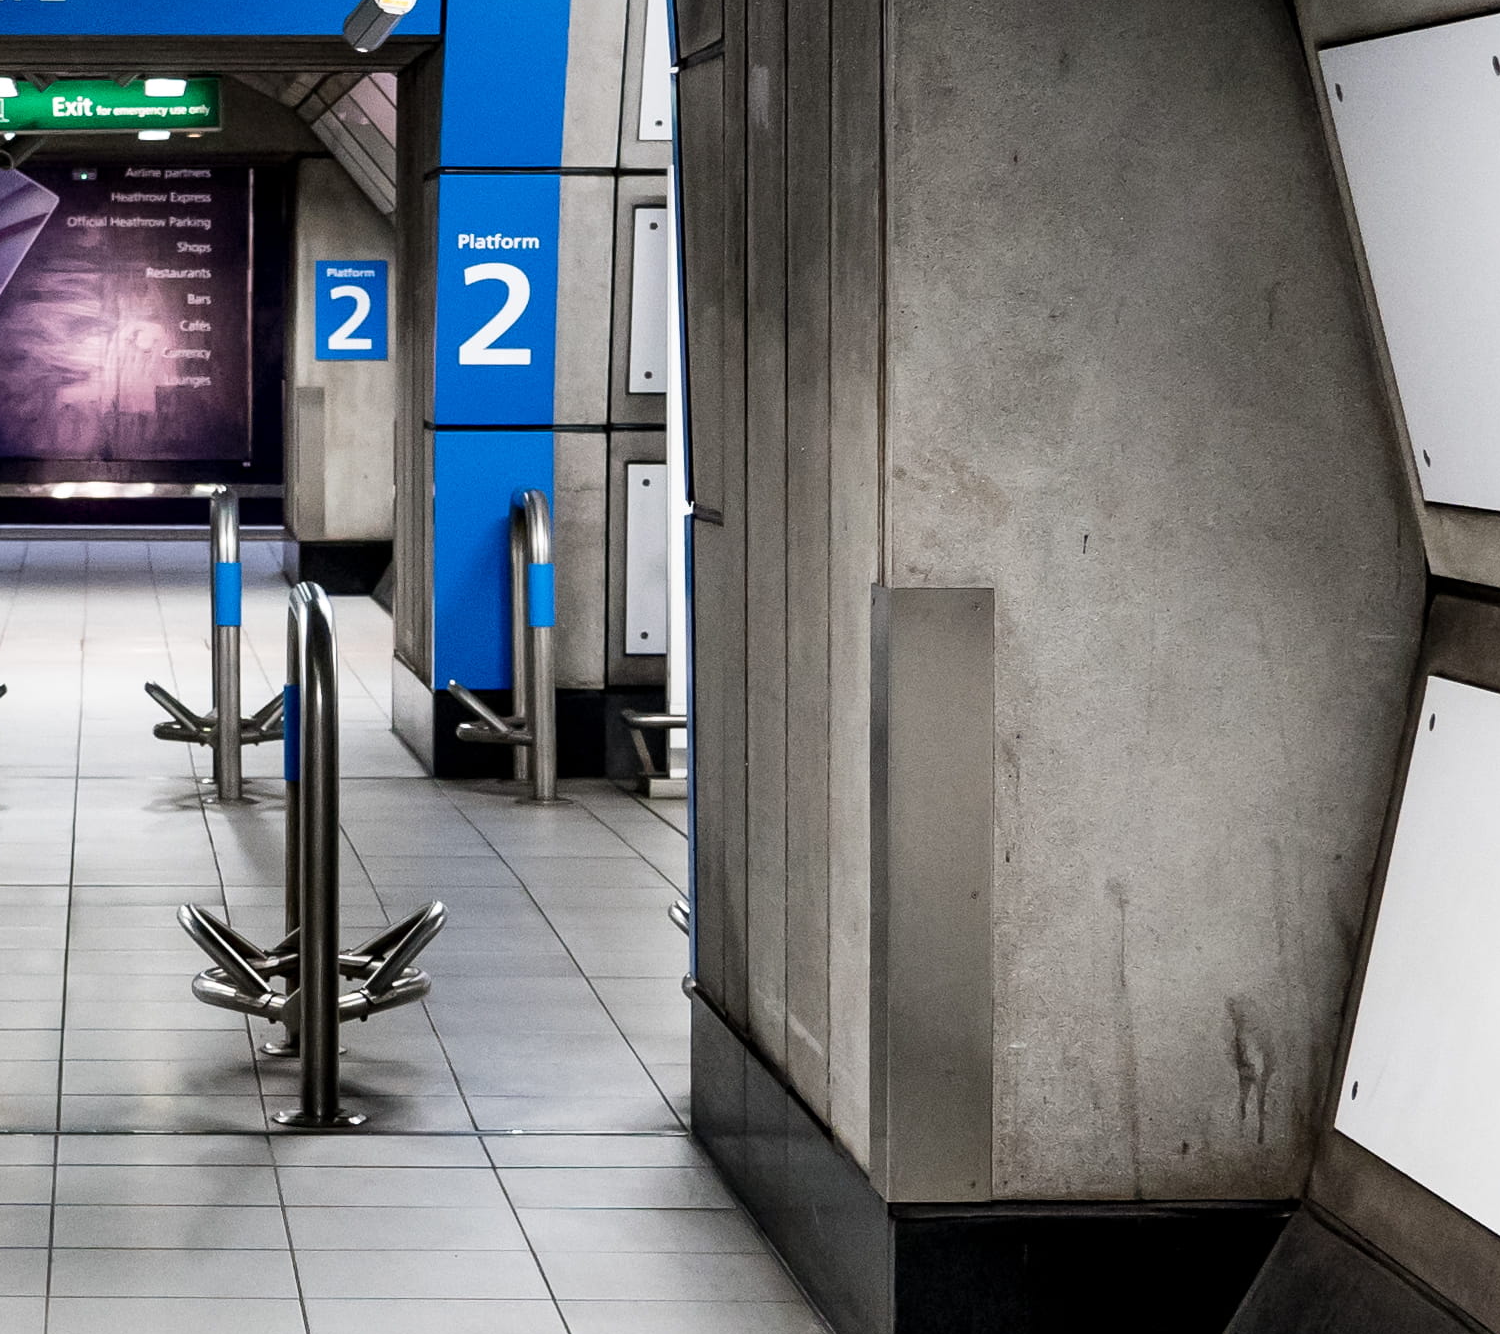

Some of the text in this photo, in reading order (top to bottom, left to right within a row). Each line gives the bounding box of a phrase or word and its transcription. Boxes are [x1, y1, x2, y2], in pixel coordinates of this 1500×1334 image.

[52, 96, 211, 118] Exit for emergency use only
[125, 167, 211, 180] Airline partners
[111, 192, 211, 204] Heathrow Express
[67, 216, 211, 230] Official Heathrow Parking
[176, 241, 212, 254] Shops
[458, 234, 540, 249] Platform
[146, 267, 211, 279] Restaurants
[327, 268, 375, 278] Platform
[187, 293, 211, 305] Bars
[328, 285, 372, 350] 2
[459, 262, 531, 365] 2
[162, 348, 211, 361] Currency
[165, 376, 211, 388] Lounges
